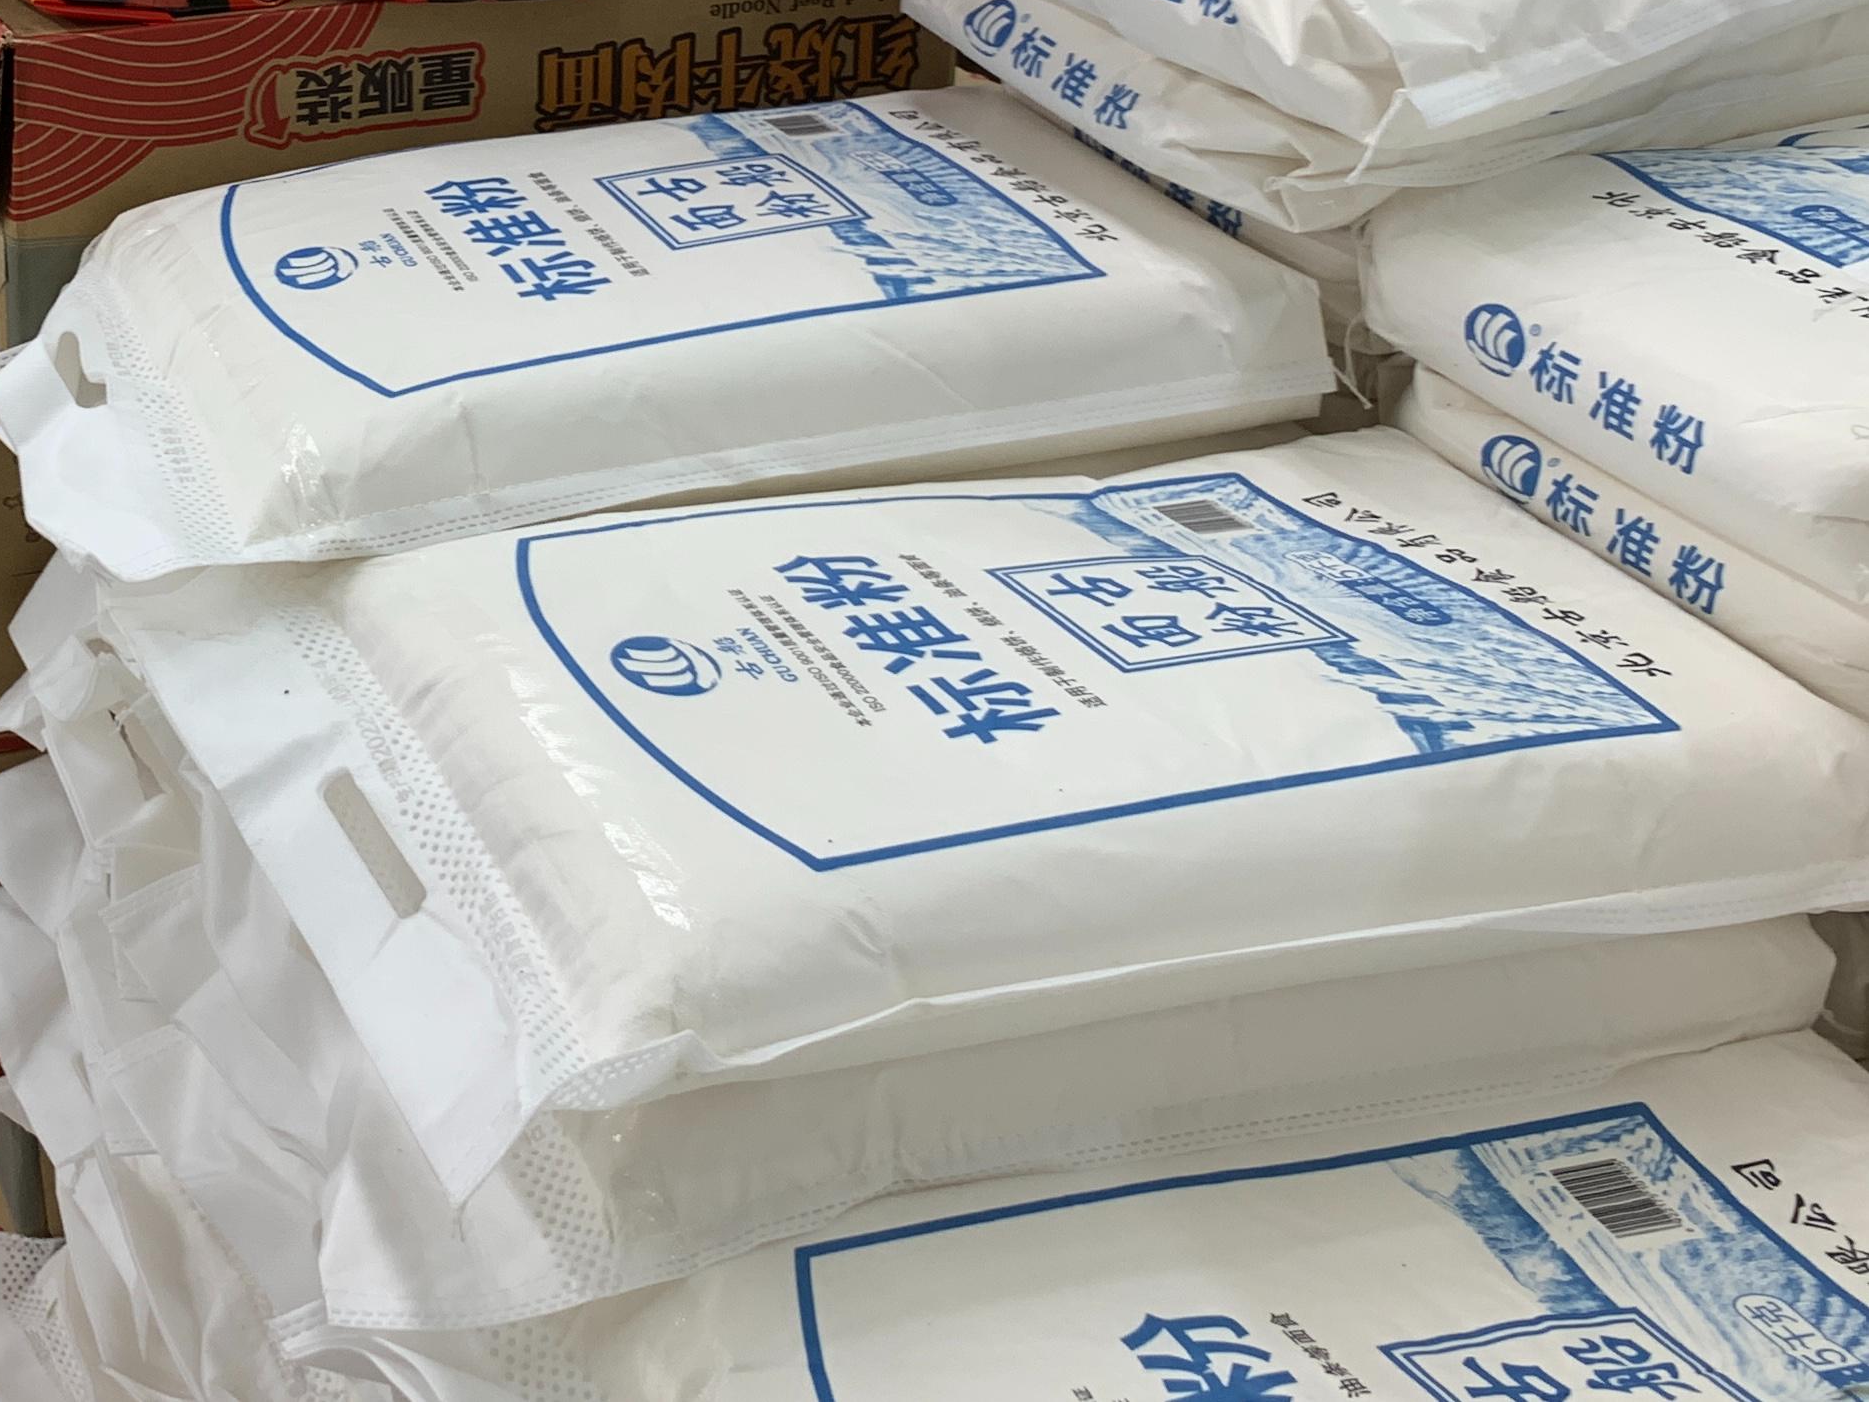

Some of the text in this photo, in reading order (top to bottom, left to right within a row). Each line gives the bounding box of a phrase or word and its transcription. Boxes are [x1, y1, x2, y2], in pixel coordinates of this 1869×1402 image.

[536, 13, 921, 133] 红烧牛肉面
[1011, 27, 1140, 129] 标准粉
[424, 177, 612, 301] 标准粉
[1529, 342, 1705, 475] 标准粉
[1302, 492, 1672, 678] 北京古船食品有限公司
[1546, 474, 1725, 615] 标准粉
[712, 636, 765, 680] 古船
[736, 627, 799, 683] GUCHUAN
[772, 554, 1061, 744] 标准粉
